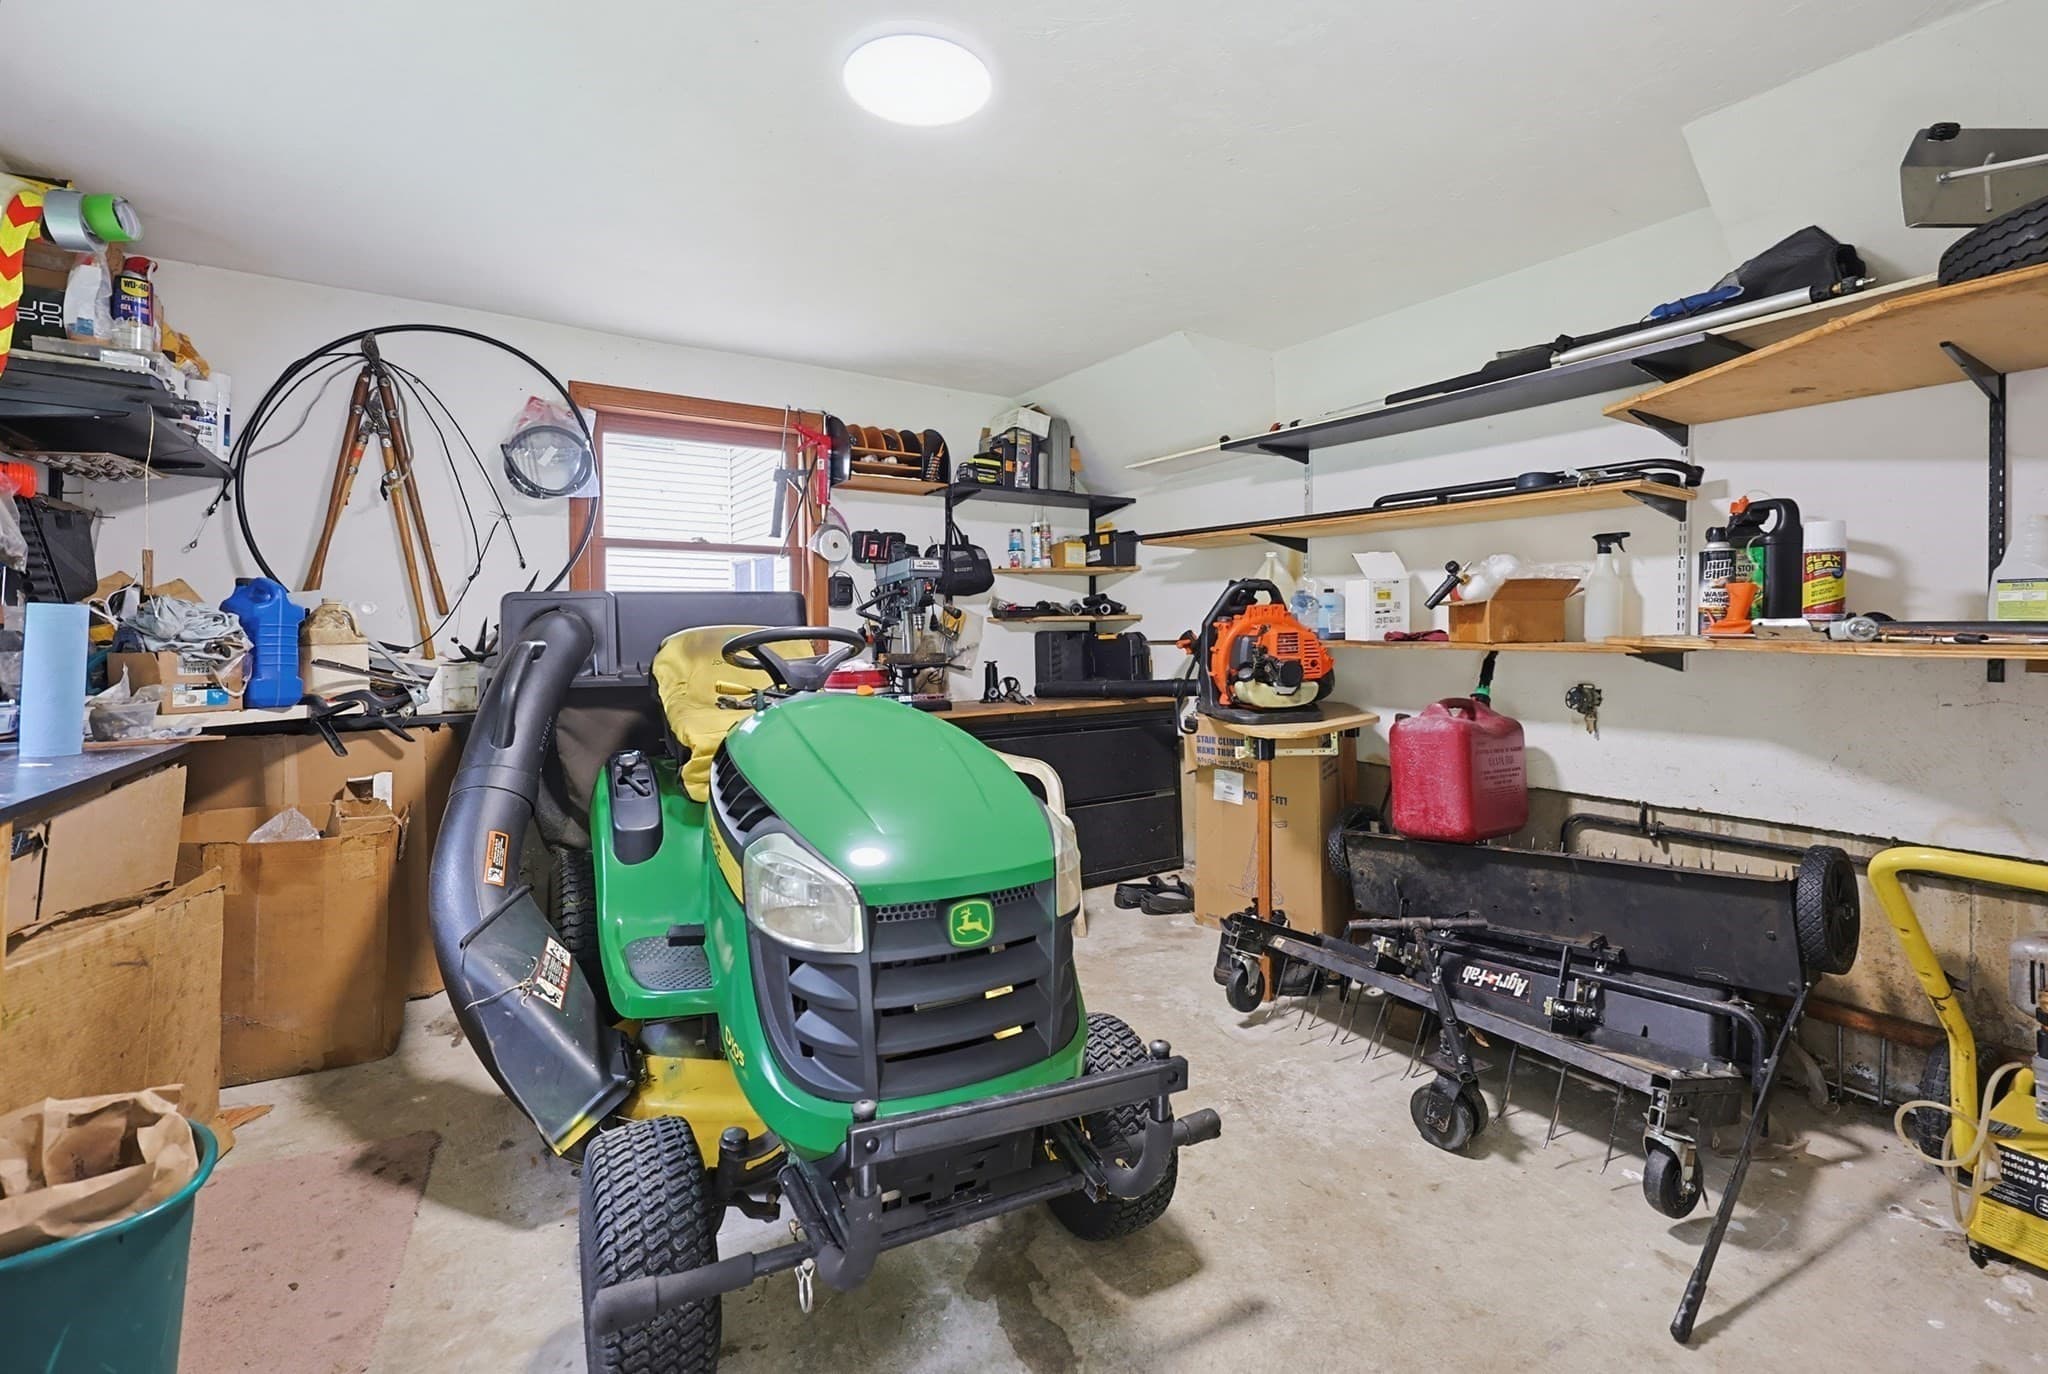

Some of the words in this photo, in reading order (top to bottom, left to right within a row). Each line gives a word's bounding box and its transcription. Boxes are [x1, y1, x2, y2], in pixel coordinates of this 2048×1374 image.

[123, 280, 149, 293] WD-40
[1705, 559, 1732, 571] HOT
[1806, 554, 1841, 564] FLEX
[1806, 561, 1841, 574] SEAL
[1704, 568, 1732, 580] SHOT
